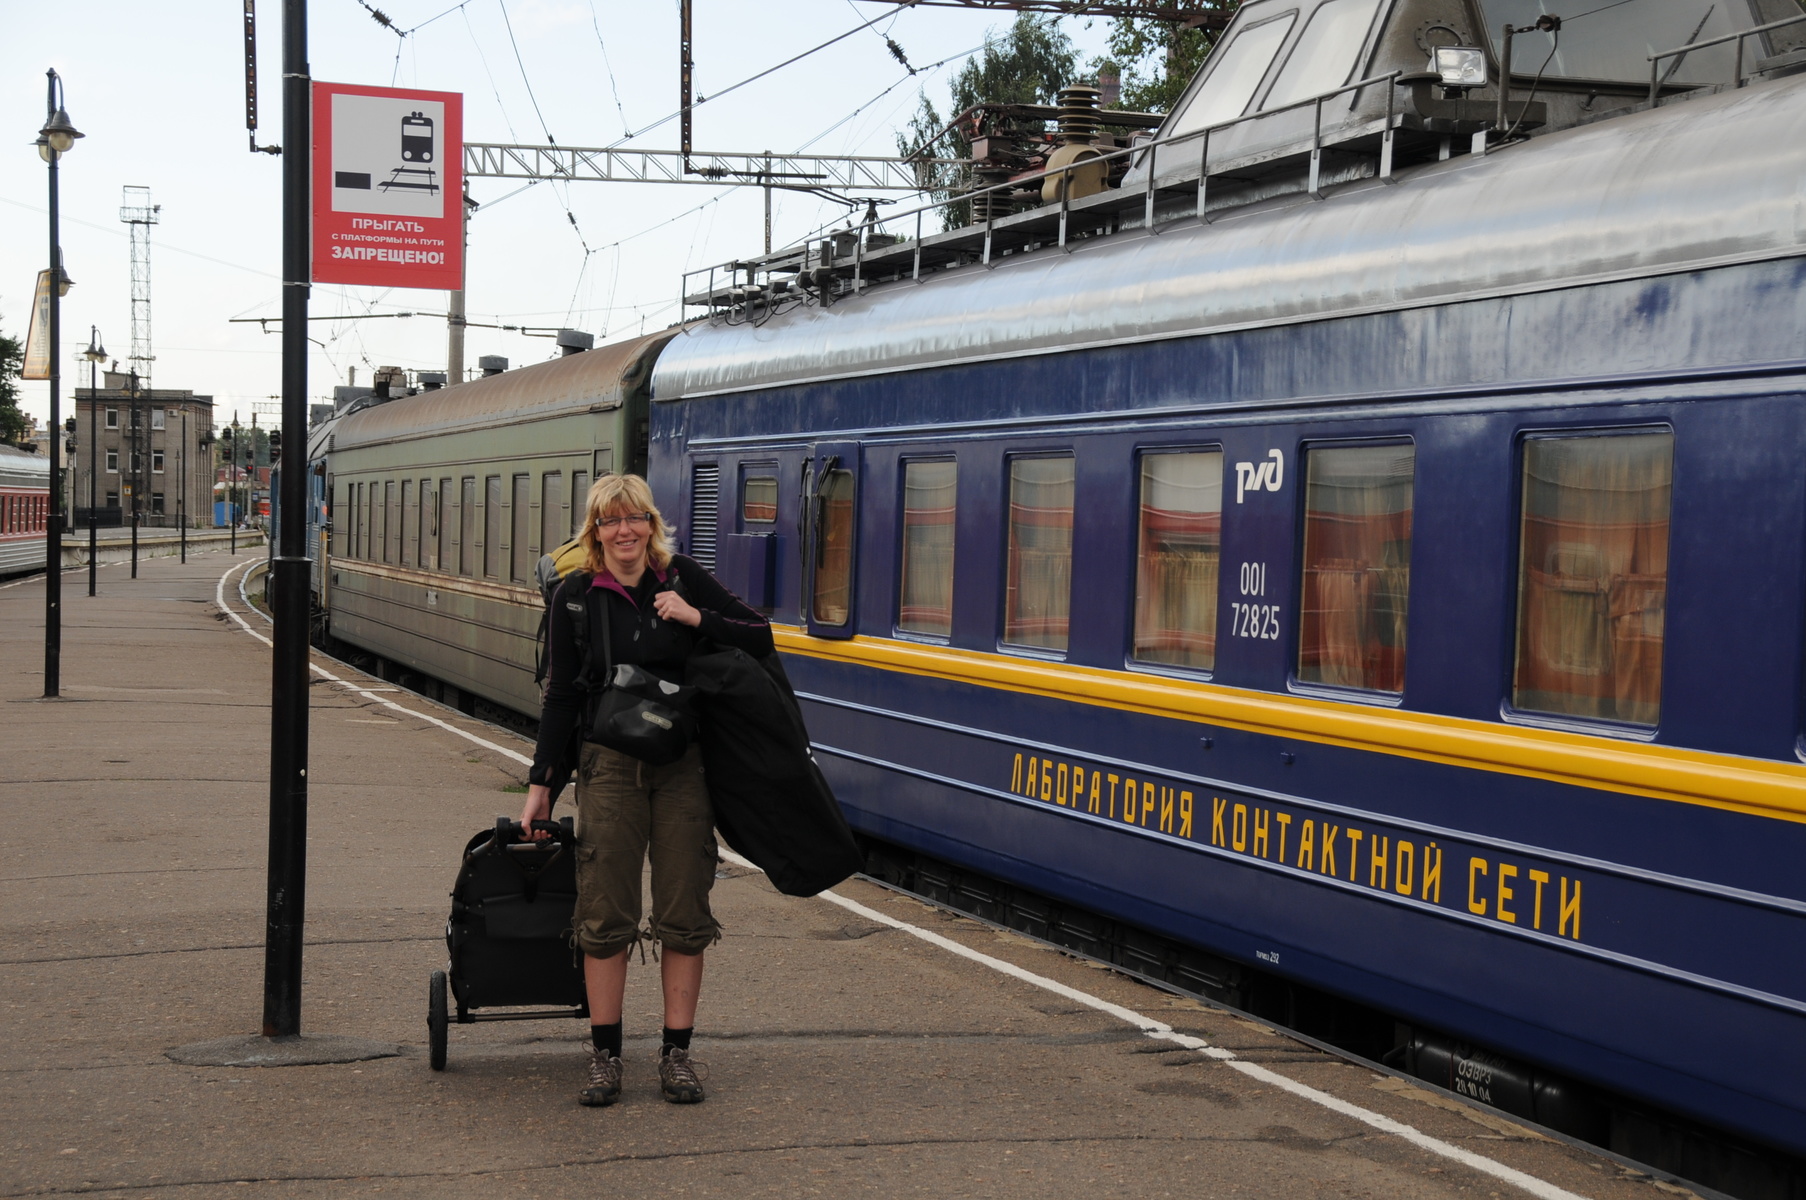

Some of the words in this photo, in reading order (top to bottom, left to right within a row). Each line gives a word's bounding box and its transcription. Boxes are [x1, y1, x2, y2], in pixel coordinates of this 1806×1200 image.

[341, 233, 403, 244] ПЛАТФОРМЫ
[352, 218, 424, 232] ПРЫГАТЬ
[331, 246, 444, 264] ЗАПРЕЩЕНО!
[1240, 561, 1266, 597] 001
[1231, 602, 1280, 641] 72825
[1010, 753, 1193, 838] ЛАБОРАТОРИЯ
[1211, 797, 1442, 903] КОНТАКТНОЙ
[1468, 856, 1581, 940] СЕТИ
